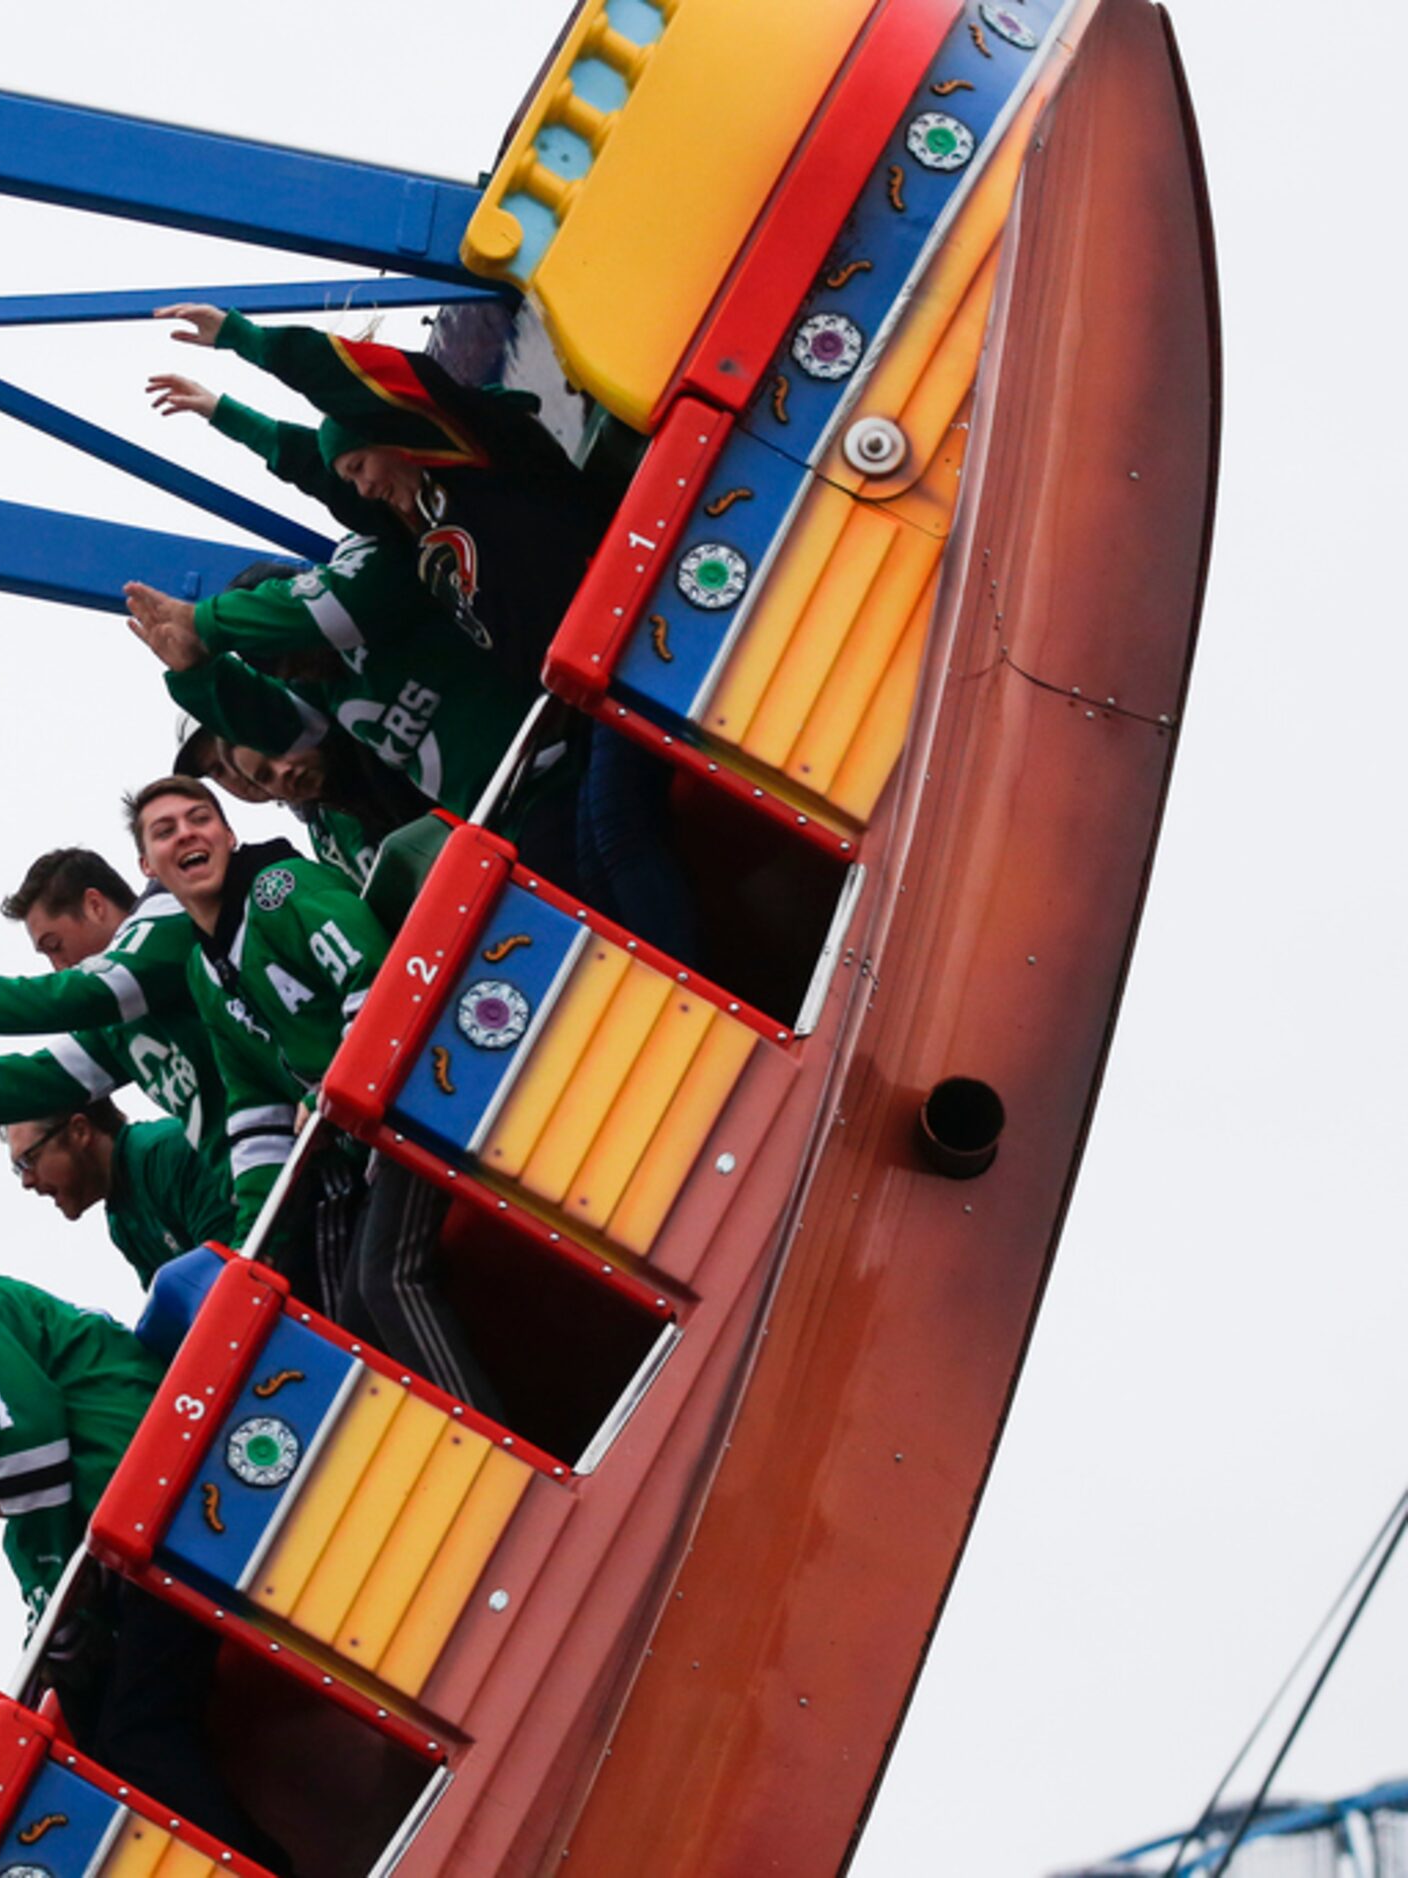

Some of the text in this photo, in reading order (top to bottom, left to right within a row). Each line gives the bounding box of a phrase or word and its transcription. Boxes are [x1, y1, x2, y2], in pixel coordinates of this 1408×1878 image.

[628, 531, 656, 551] 1
[309, 919, 363, 986] 91
[406, 955, 439, 985] 2
[264, 961, 315, 1015] A
[175, 1393, 205, 1420] 3
